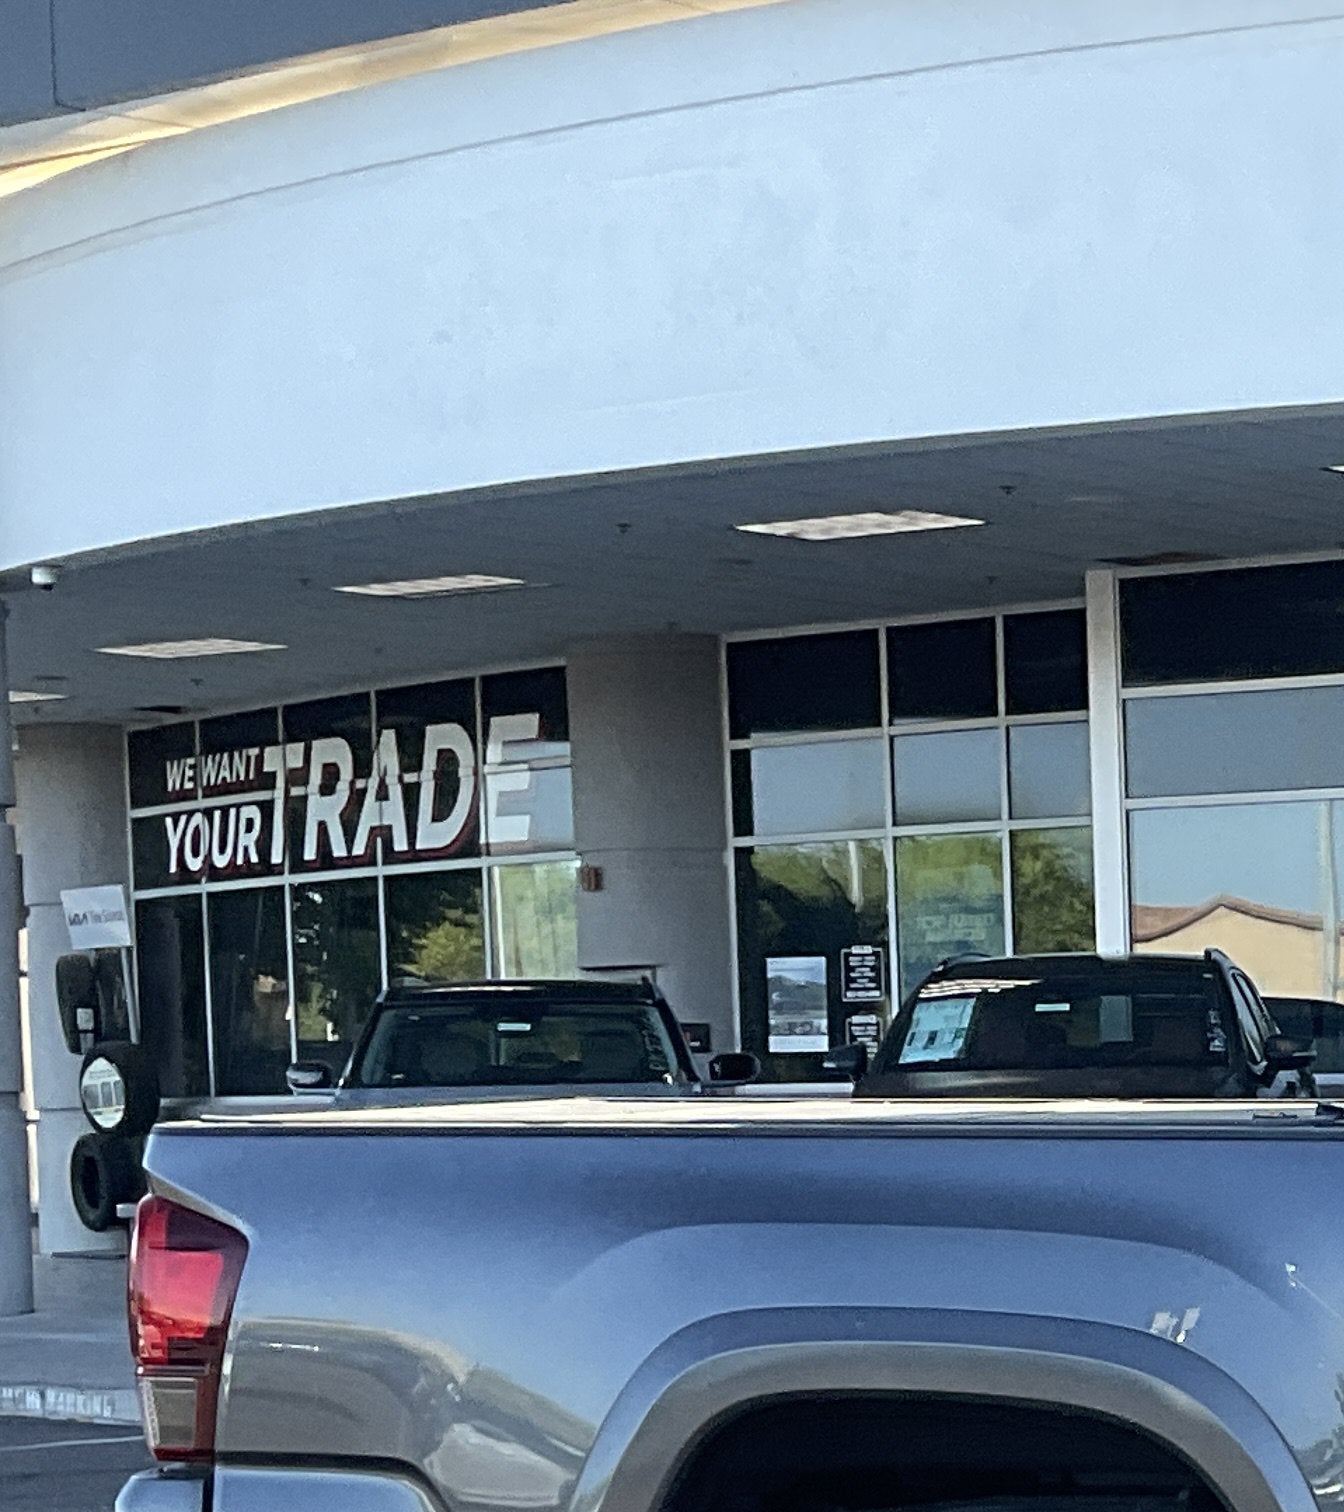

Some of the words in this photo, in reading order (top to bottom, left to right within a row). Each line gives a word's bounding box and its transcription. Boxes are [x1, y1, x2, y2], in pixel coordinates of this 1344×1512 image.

[165, 804, 261, 874] YOUR
[263, 713, 541, 865] TRADE
[166, 756, 196, 792] WE
[201, 748, 259, 786] WANT
